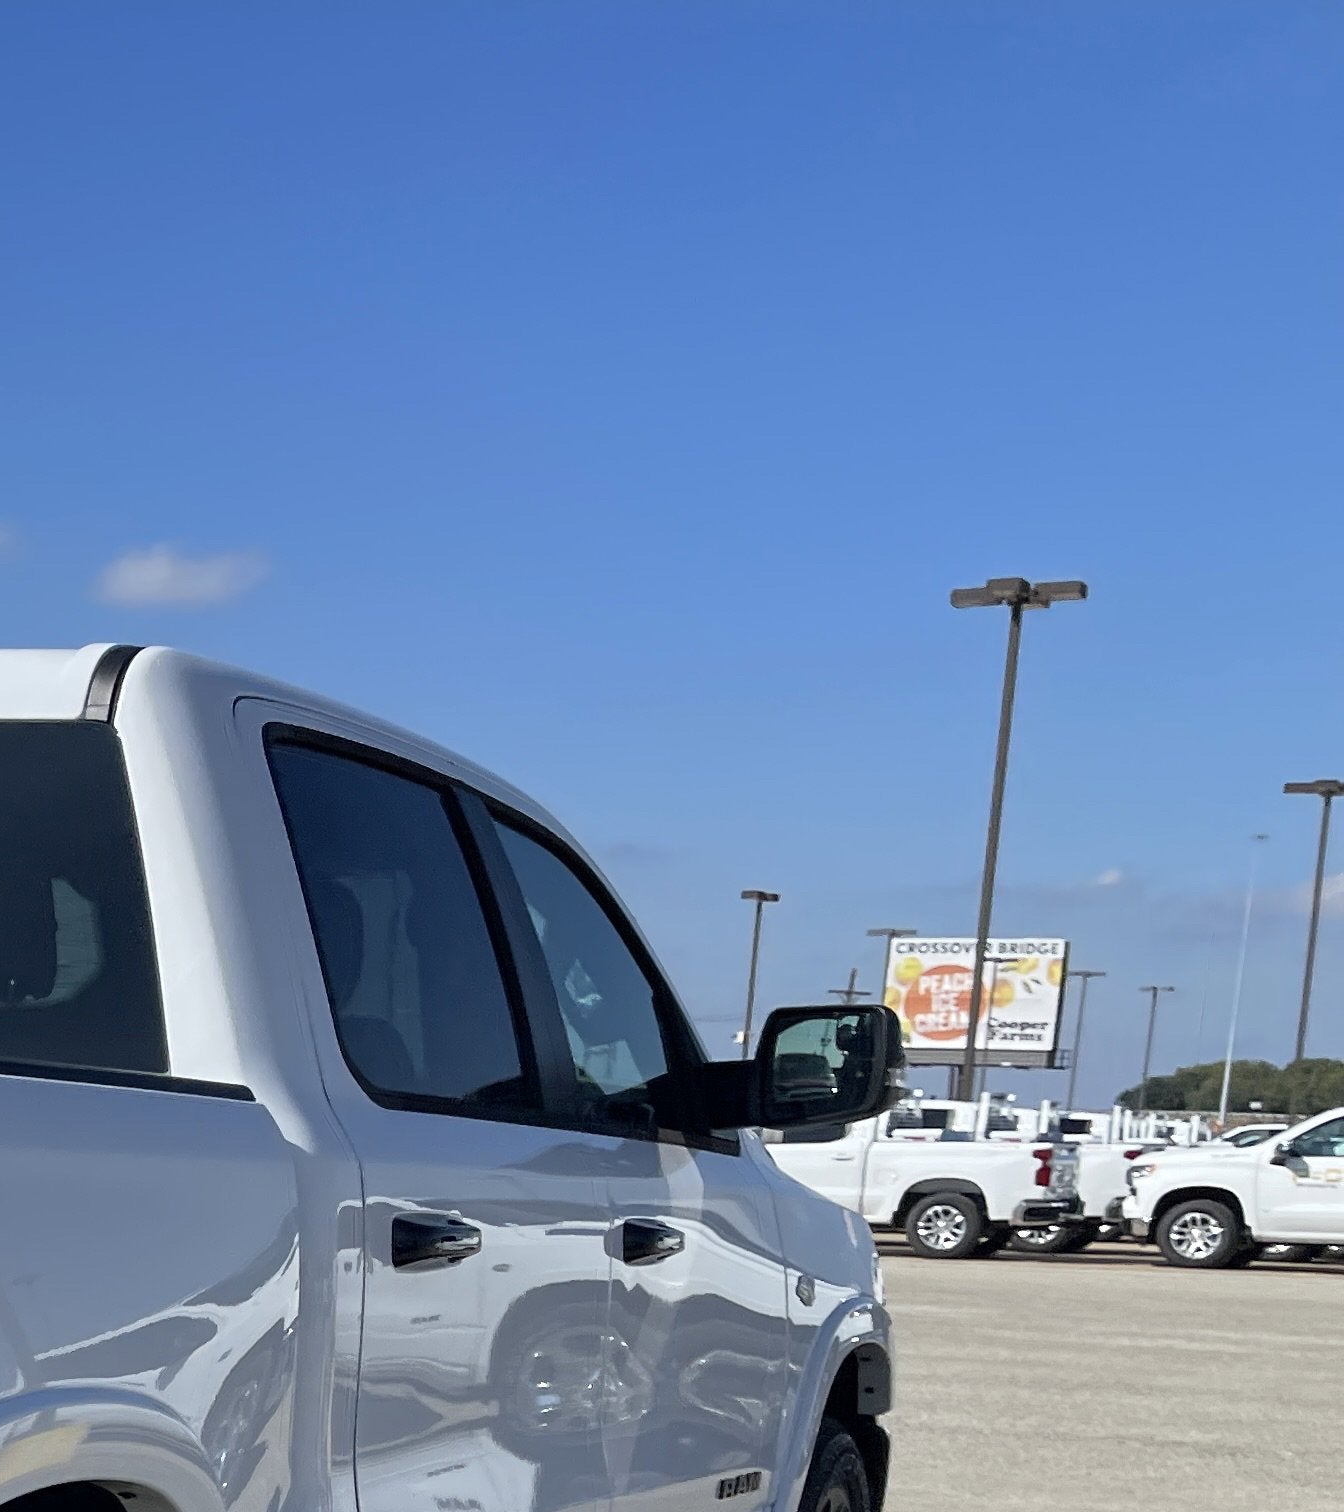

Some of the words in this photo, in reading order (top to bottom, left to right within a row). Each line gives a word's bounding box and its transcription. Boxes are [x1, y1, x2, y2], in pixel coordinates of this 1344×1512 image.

[895, 942, 993, 954] CROSSOVR
[998, 942, 1059, 954] BRIDGE
[931, 992, 960, 1012] ICE
[988, 1016, 1049, 1031] Cooper
